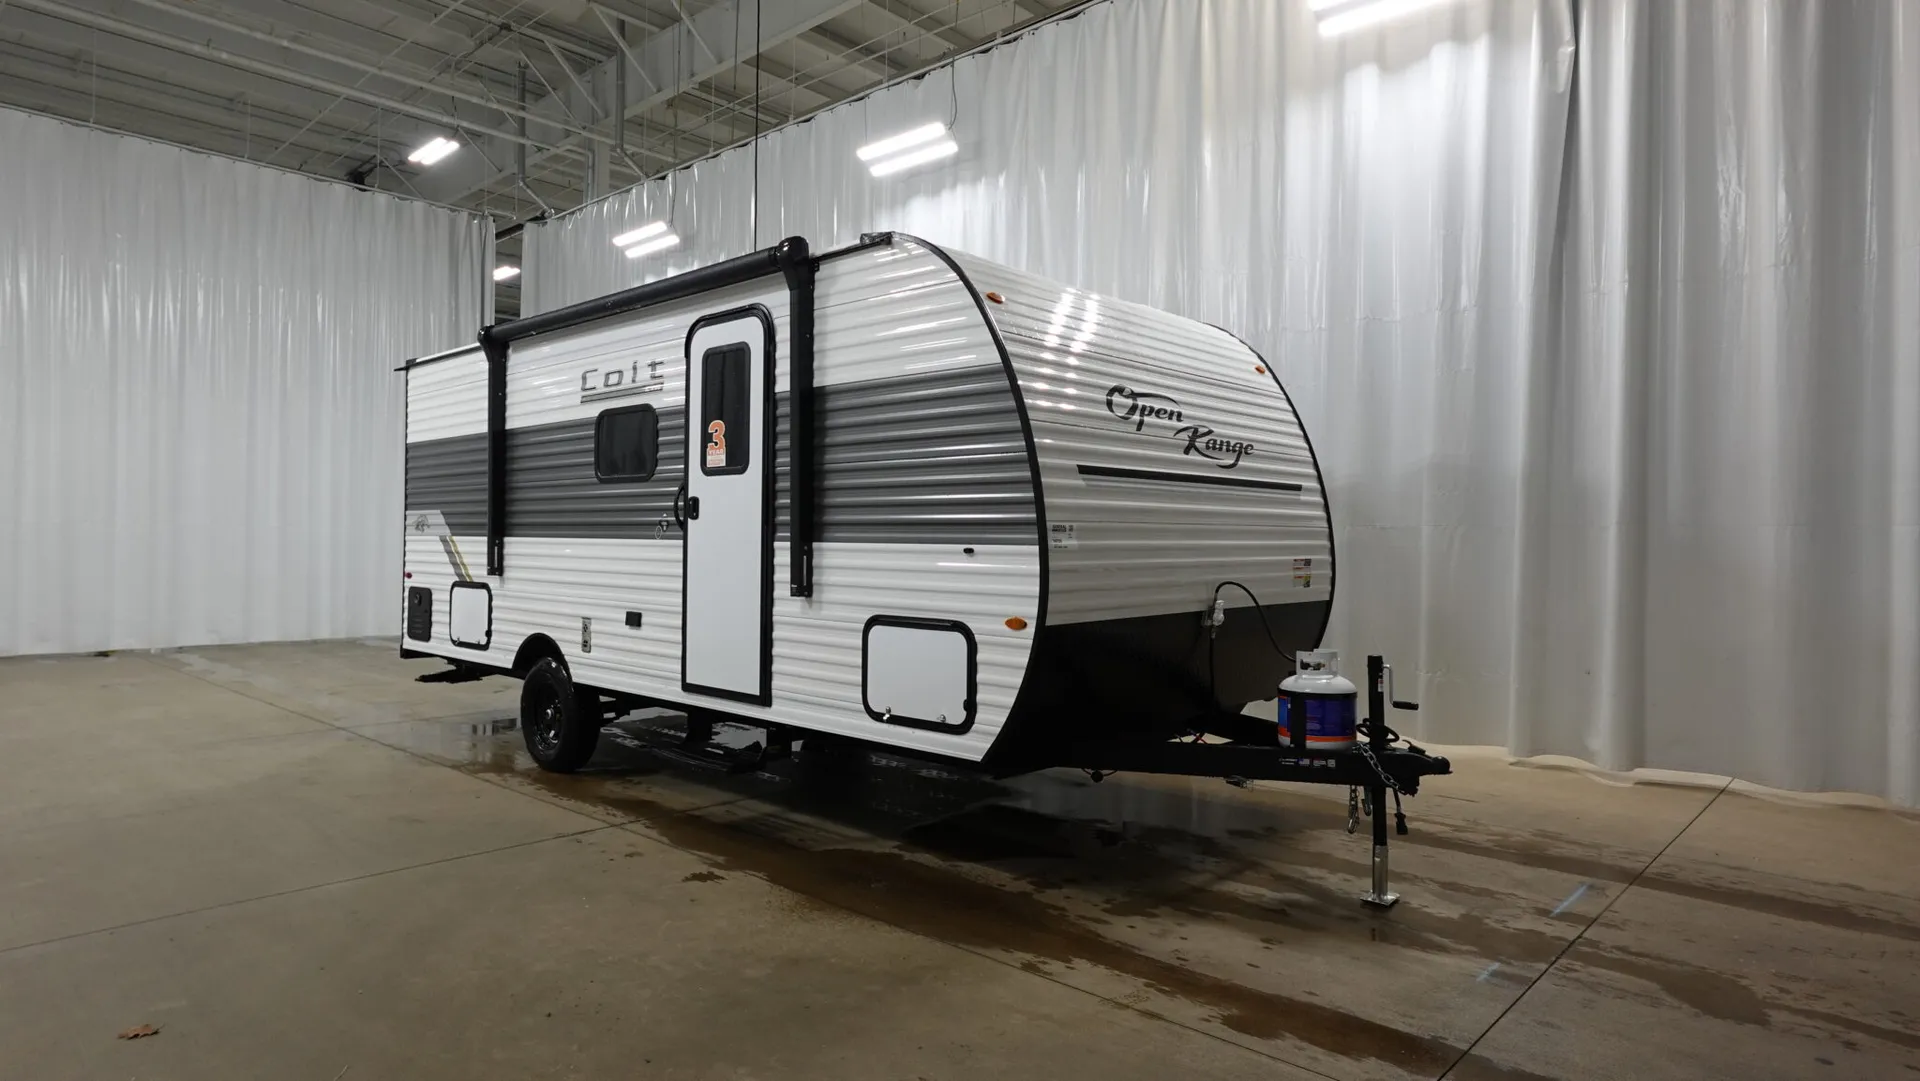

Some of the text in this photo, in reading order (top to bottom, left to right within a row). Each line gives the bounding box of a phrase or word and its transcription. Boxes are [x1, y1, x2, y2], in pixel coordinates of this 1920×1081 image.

[1106, 384, 1184, 432] Open
[708, 420, 726, 450] 3
[1173, 425, 1255, 469] Range
